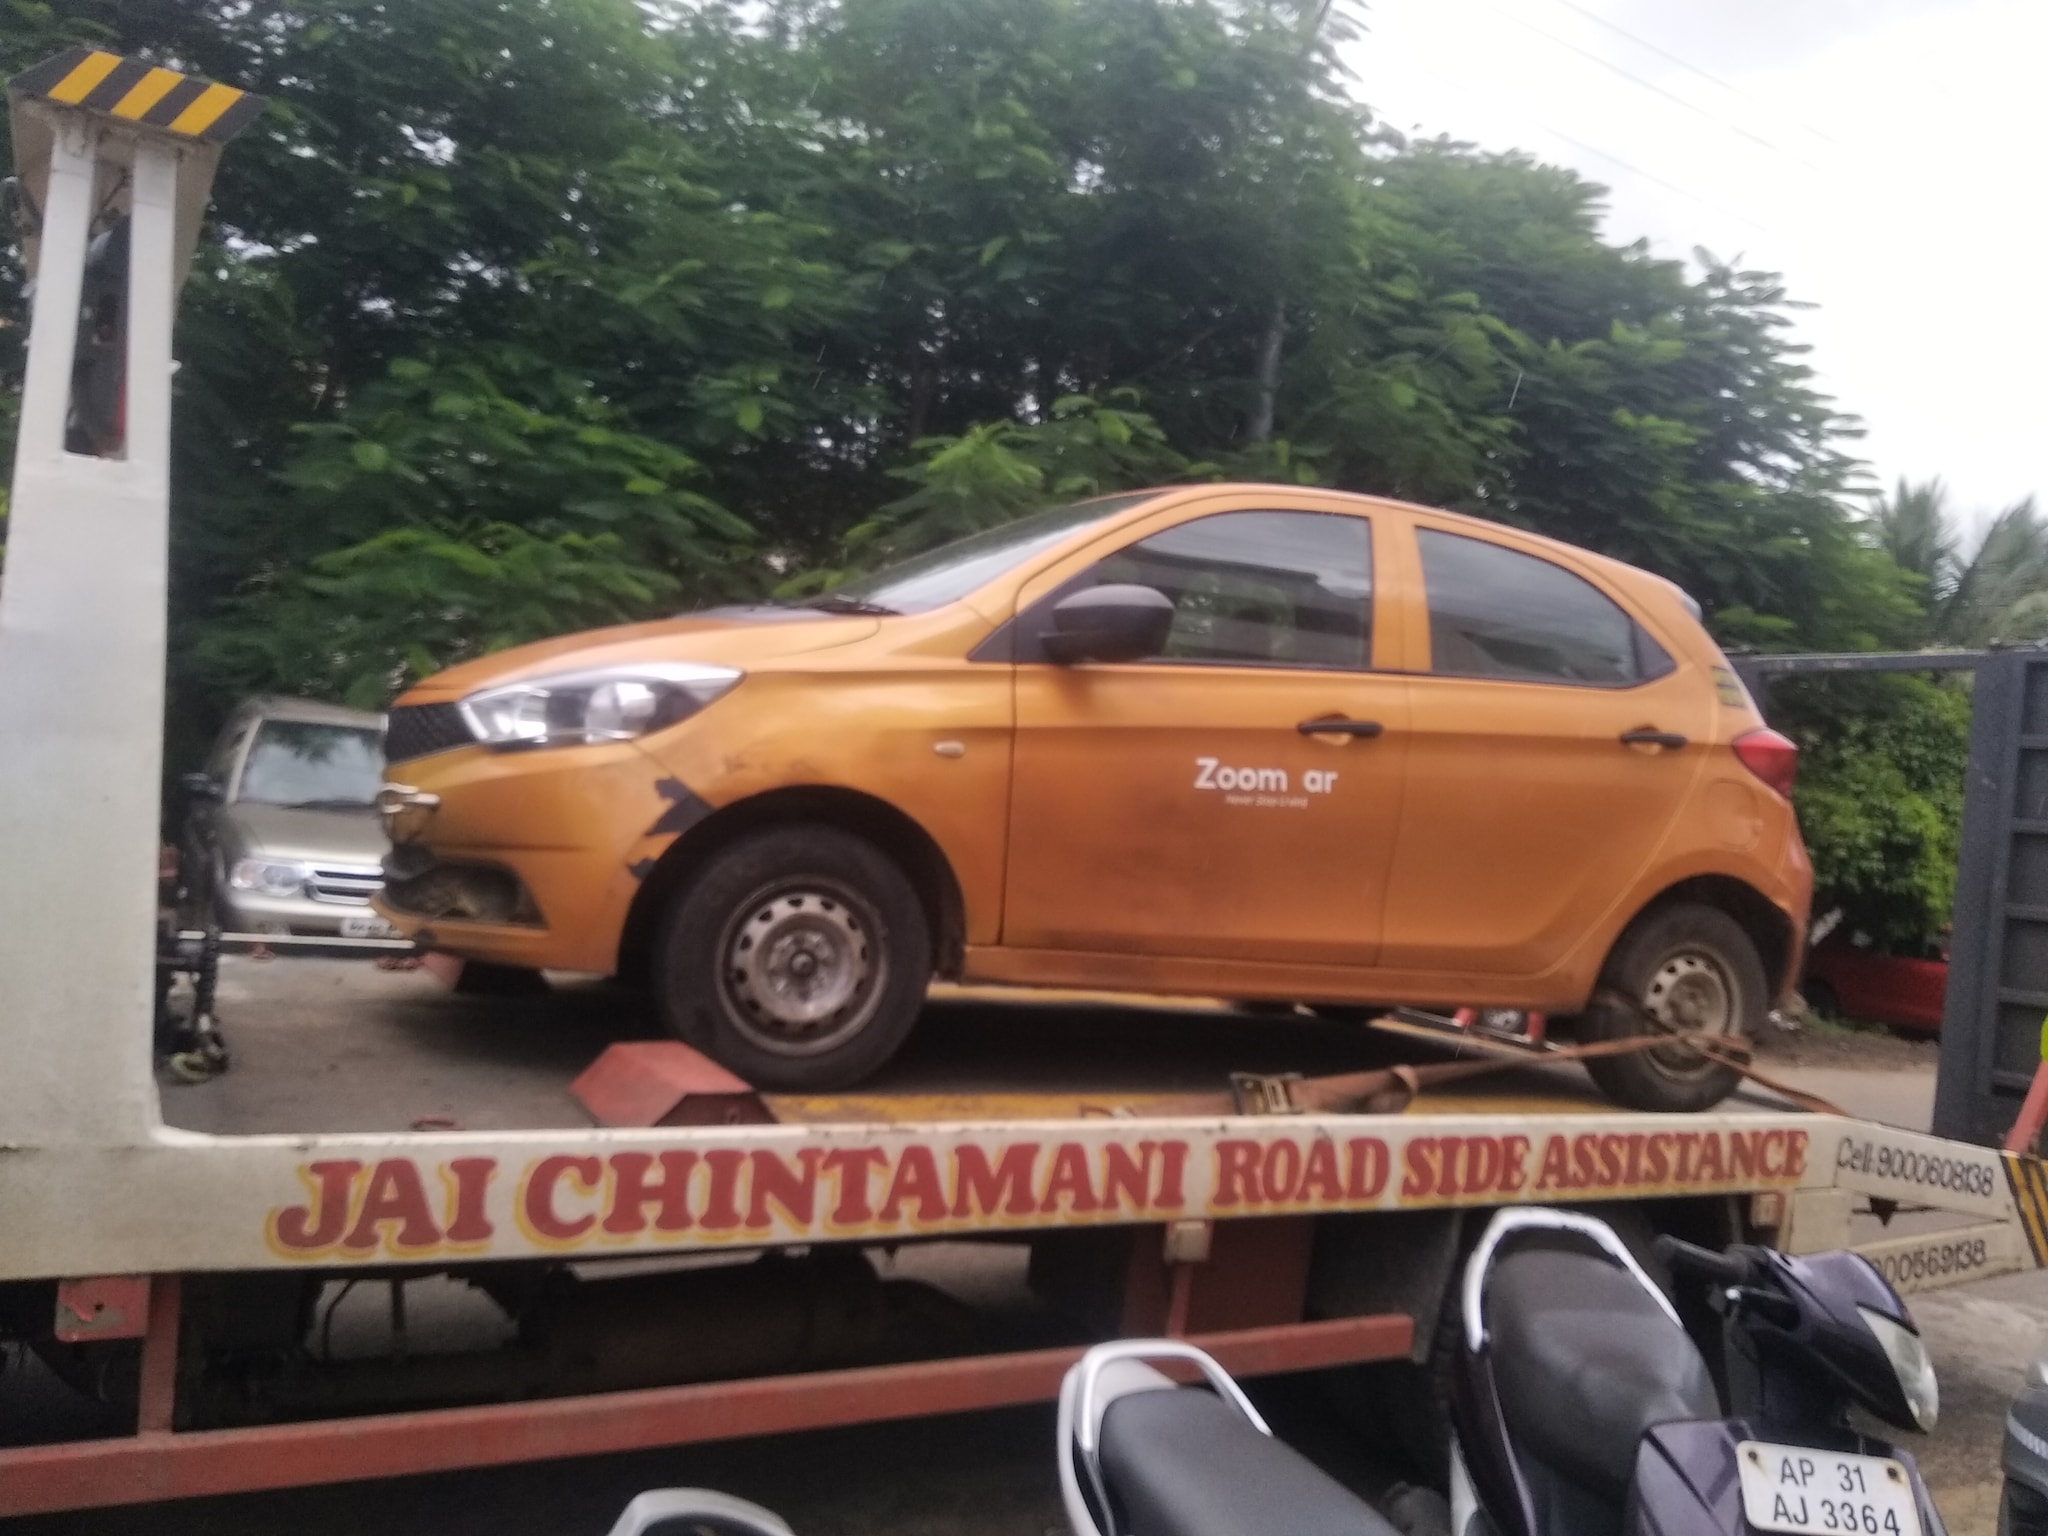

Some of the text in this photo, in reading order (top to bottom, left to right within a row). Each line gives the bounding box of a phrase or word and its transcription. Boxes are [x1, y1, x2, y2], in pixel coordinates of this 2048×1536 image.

[1195, 757, 1288, 792] Zoom
[266, 1129, 1808, 1260] JAI CHINTAMANI ROAD SIDE ASSISTANCE
[1780, 1457, 1866, 1494] AP 31
[1773, 1494, 1901, 1536] AJ 3364
